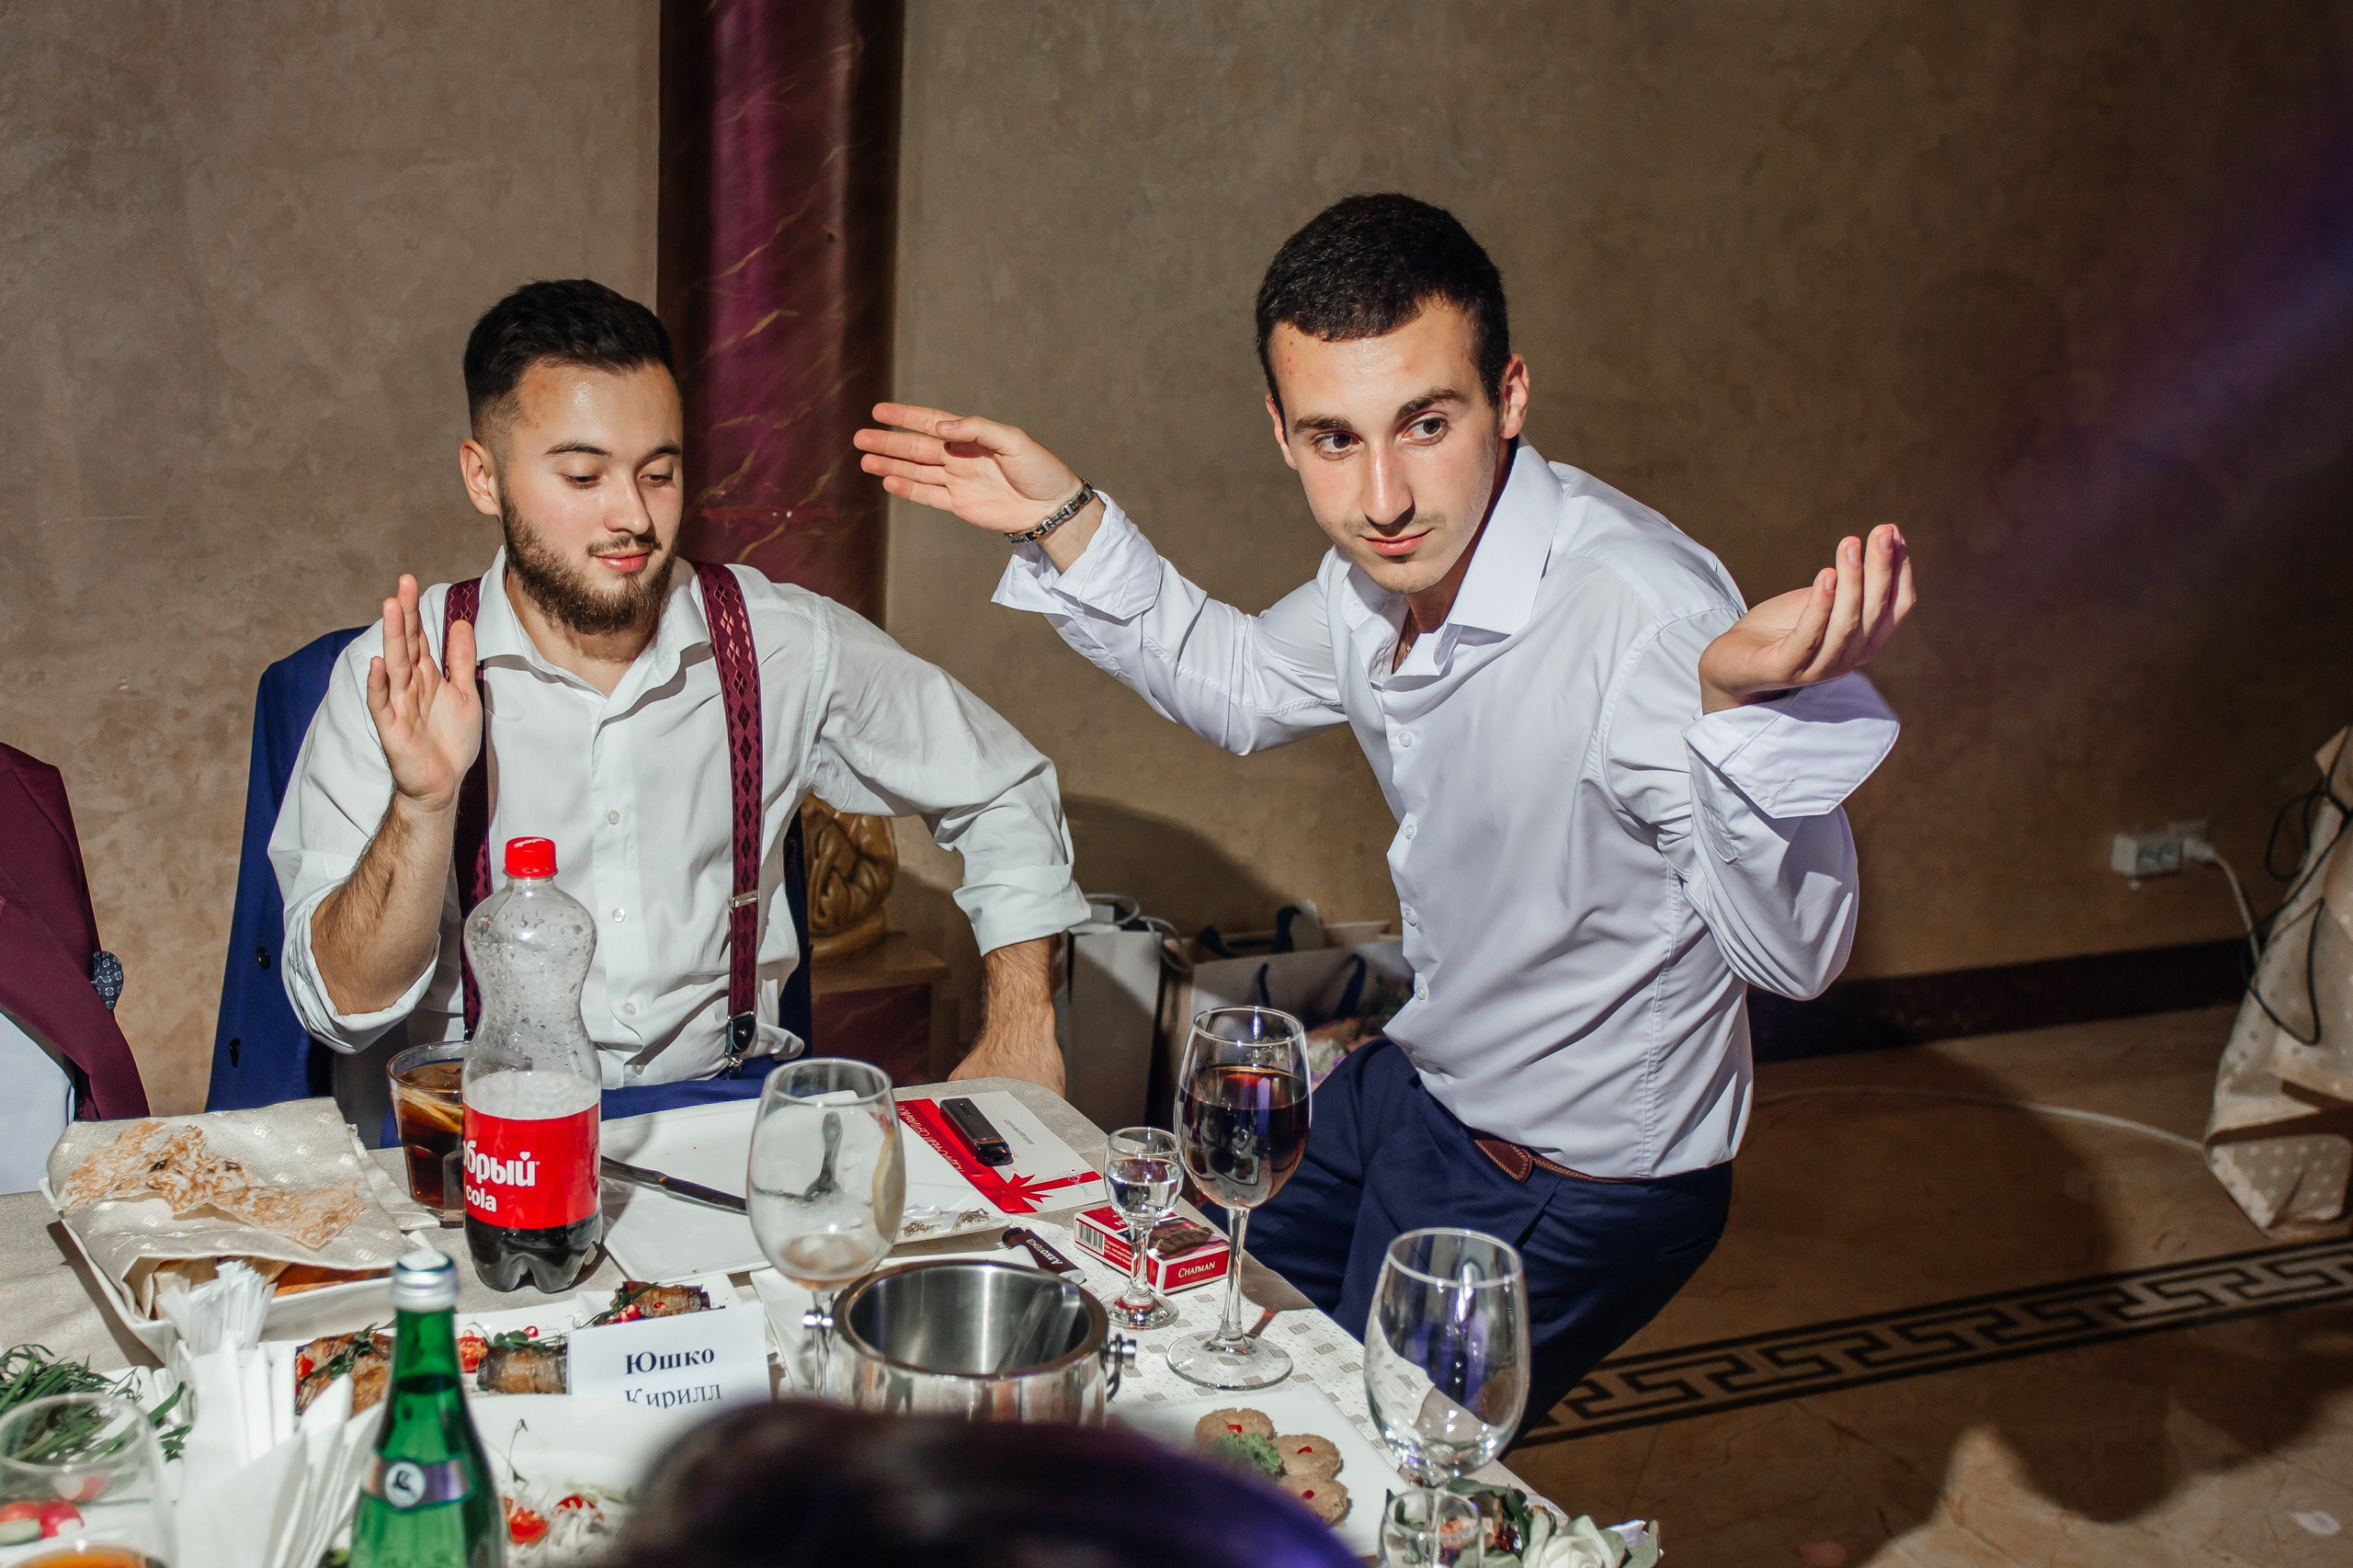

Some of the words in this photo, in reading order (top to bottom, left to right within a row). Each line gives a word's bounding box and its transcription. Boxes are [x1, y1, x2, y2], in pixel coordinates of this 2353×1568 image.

[463, 1140, 536, 1187] брый
[465, 1185, 497, 1212] cola
[624, 1348, 715, 1375] Юшко
[624, 1383, 722, 1410] Кирилл
